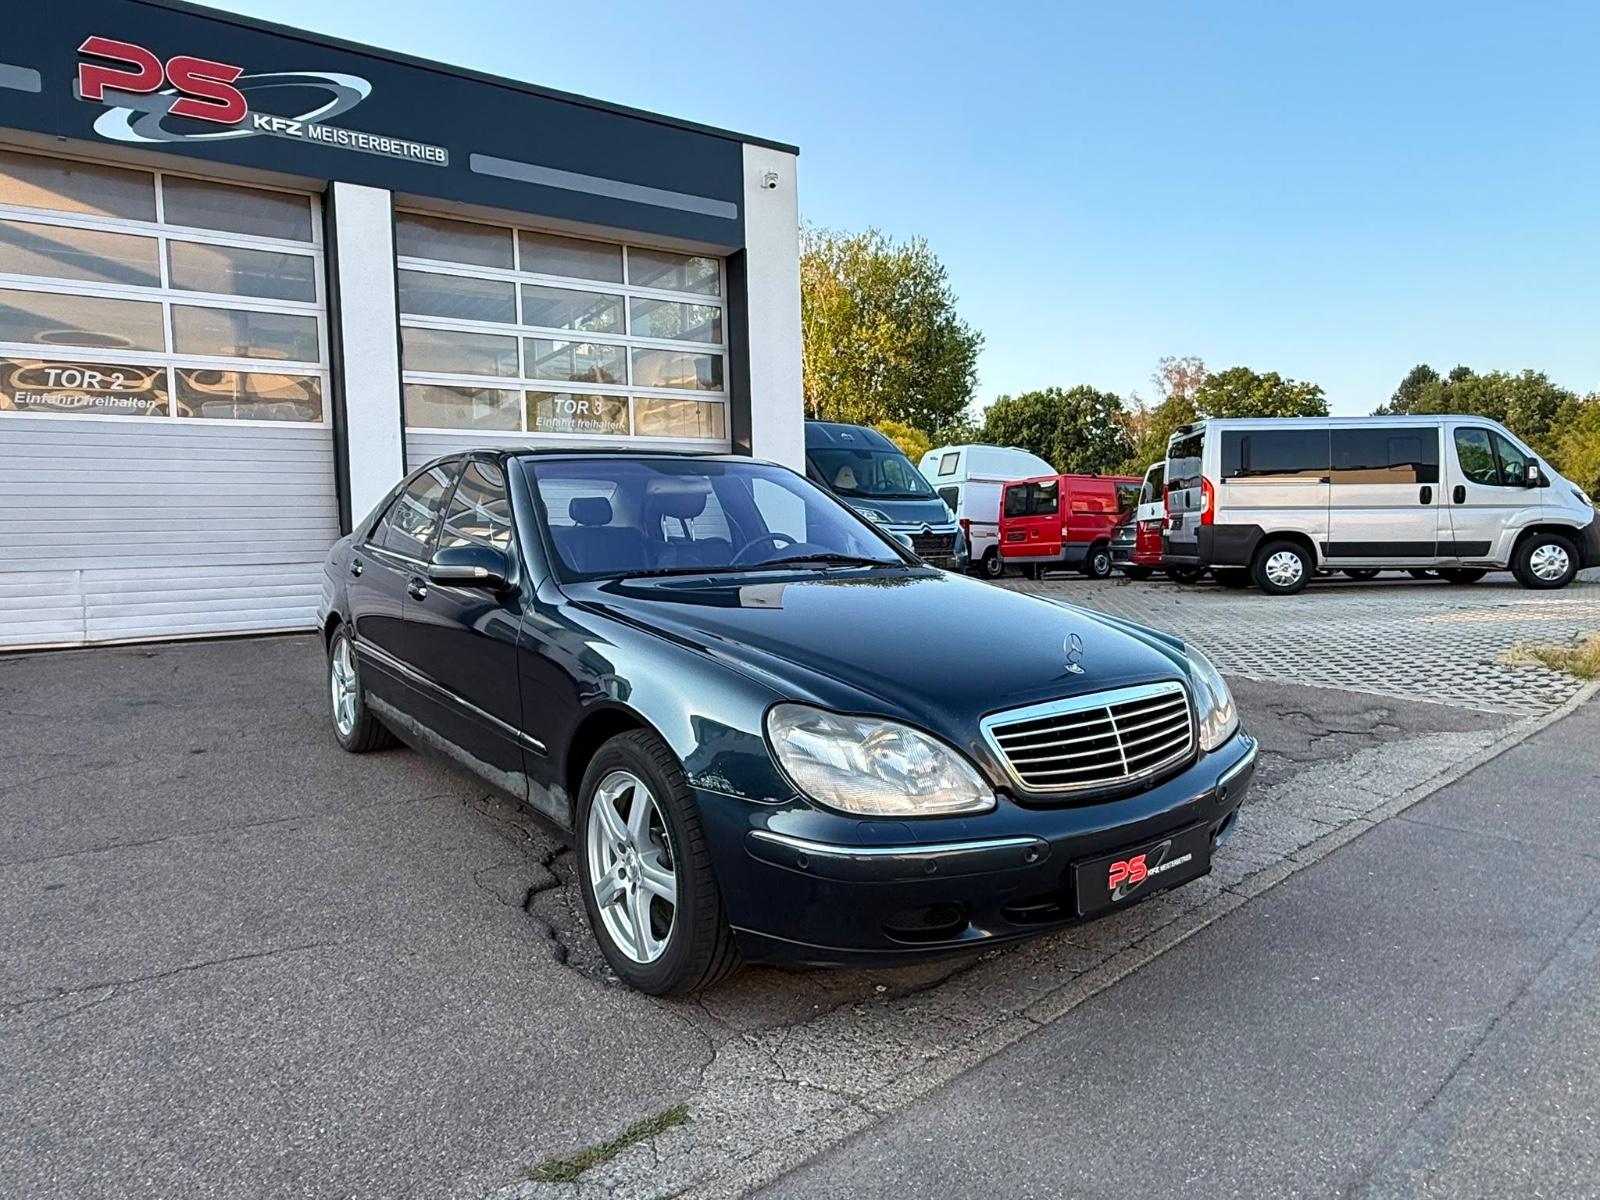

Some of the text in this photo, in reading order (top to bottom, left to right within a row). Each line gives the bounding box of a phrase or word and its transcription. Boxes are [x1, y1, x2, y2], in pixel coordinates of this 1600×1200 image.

[77, 35, 248, 124] PS
[253, 114, 446, 162] KFZ MEISTERBETRIEB
[44, 368, 124, 390] TOR 2
[14, 391, 156, 409] Einfahrt freihalten
[554, 398, 603, 415] TOR 3
[536, 417, 575, 430] Einfahrt
[1109, 854, 1147, 890] PS
